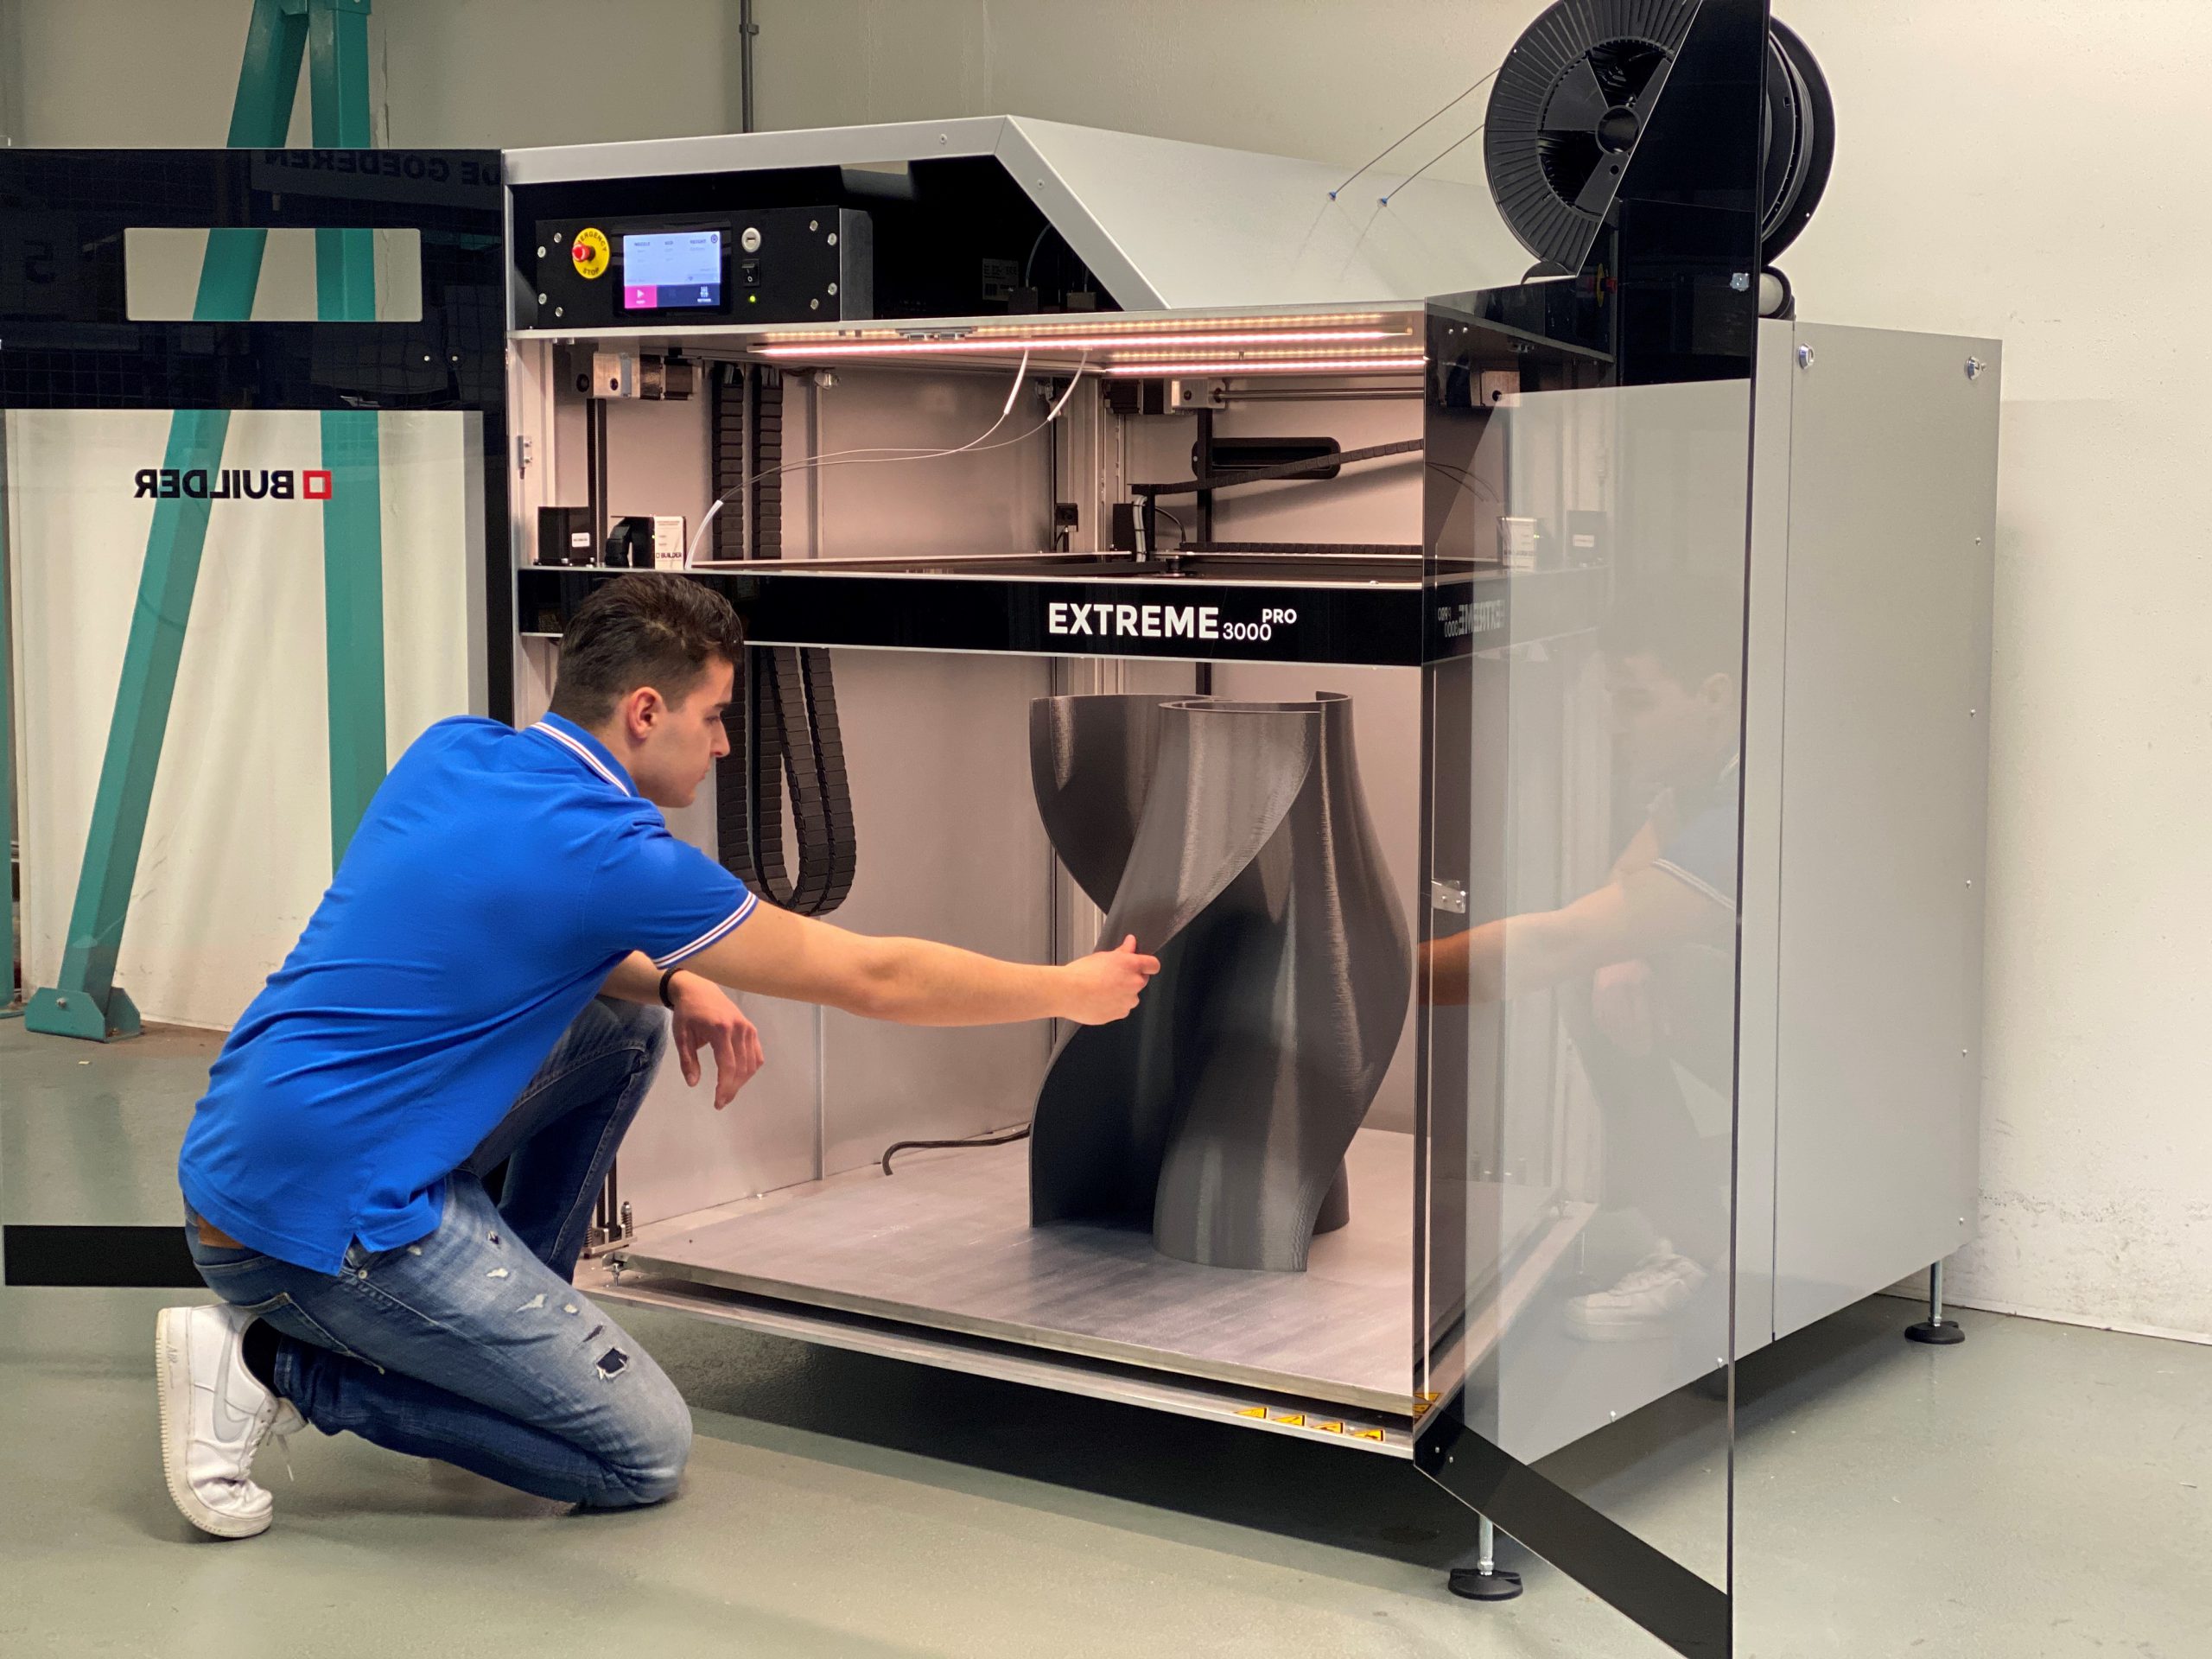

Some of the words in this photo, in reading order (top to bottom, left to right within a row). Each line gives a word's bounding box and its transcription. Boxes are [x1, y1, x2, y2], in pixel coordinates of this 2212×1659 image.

[578, 231, 607, 251] ERGENCY
[582, 267, 600, 276] STOP
[1049, 602, 1219, 639] EXTREME
[1223, 622, 1272, 641] 3000
[1262, 608, 1297, 624] PRO
